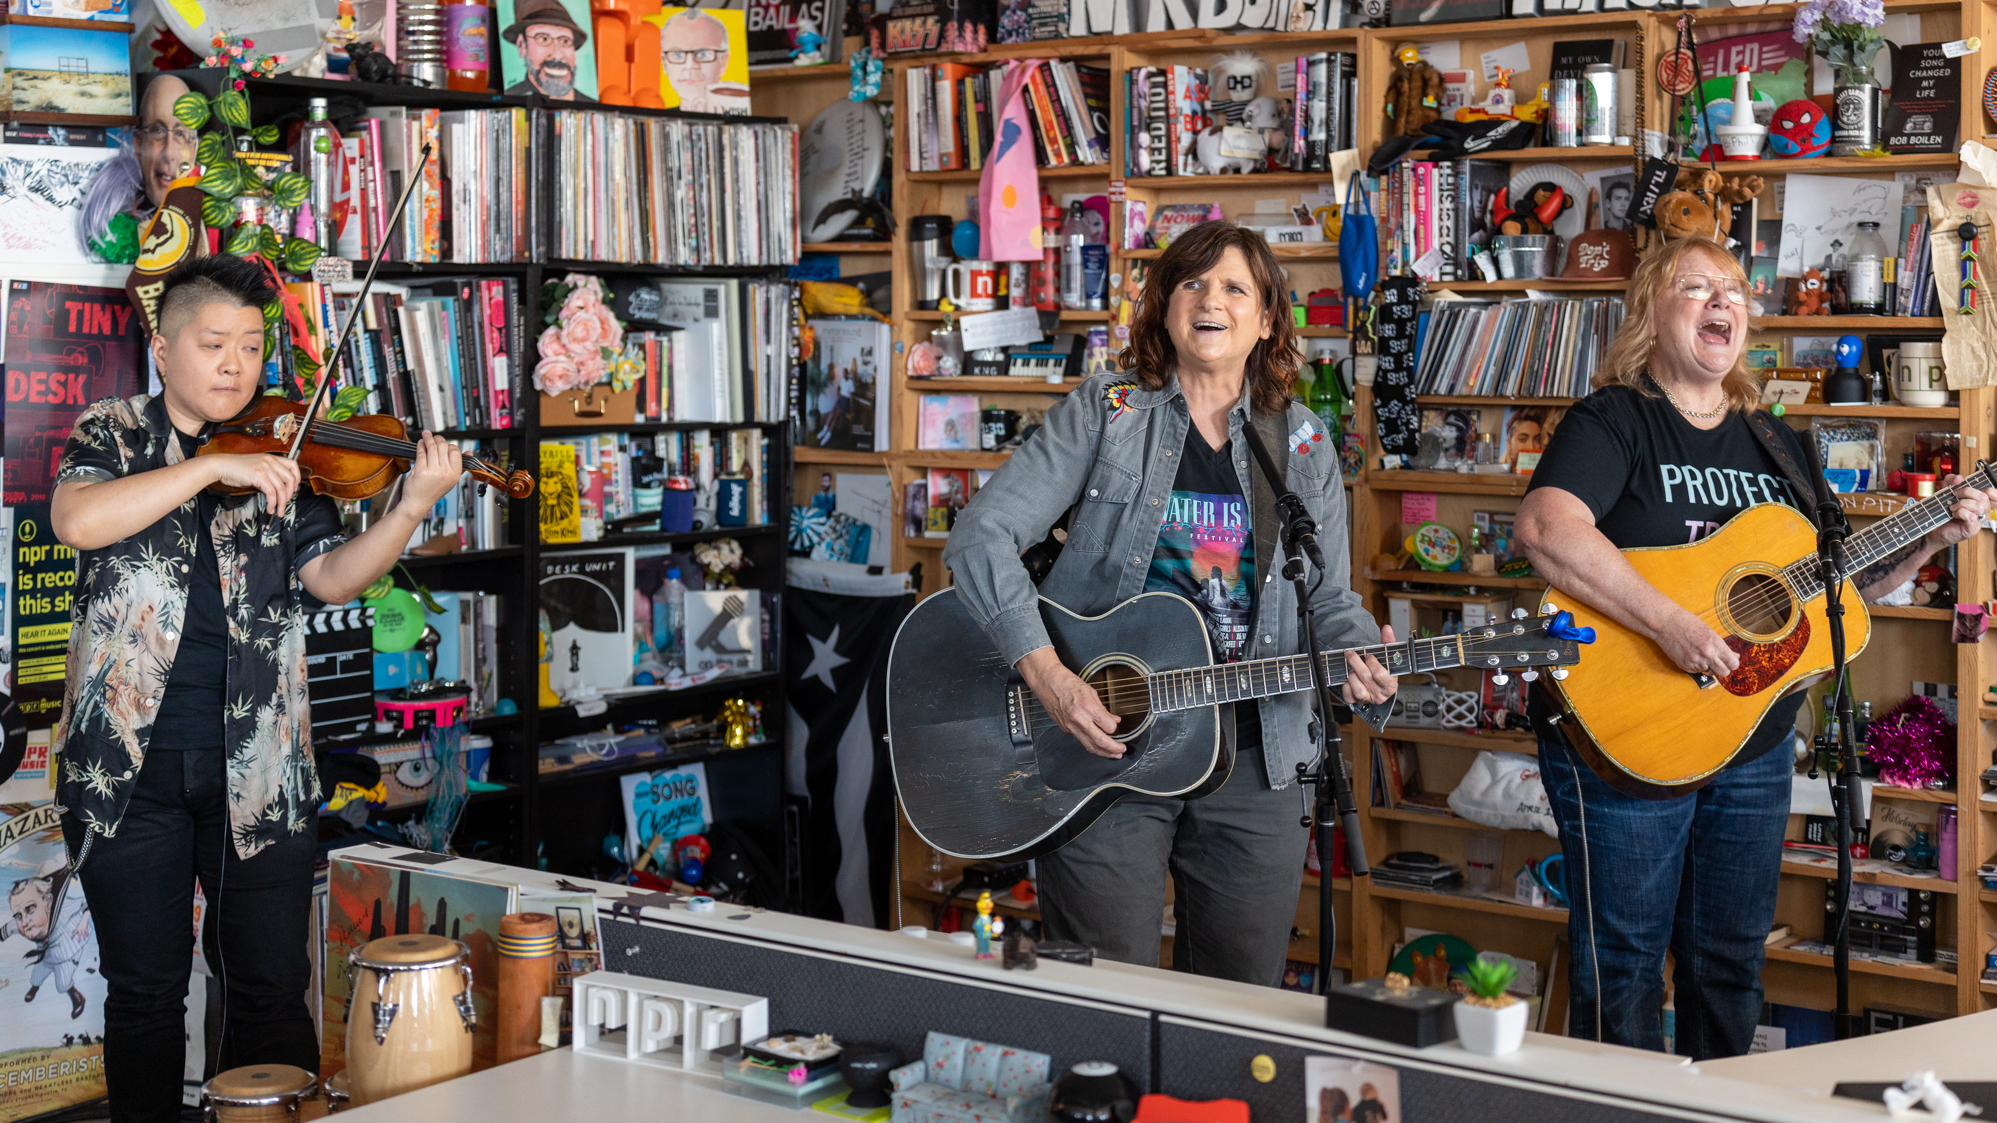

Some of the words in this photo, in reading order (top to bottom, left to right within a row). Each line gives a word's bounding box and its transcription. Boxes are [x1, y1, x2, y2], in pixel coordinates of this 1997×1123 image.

[748, 3, 822, 31] BAILAS
[886, 15, 941, 52] KISS
[1909, 68, 1951, 78] CHANGED
[1920, 59, 1944, 67] SONG
[1167, 73, 1175, 92] ASK
[1554, 70, 1583, 80] DEVI
[1921, 79, 1935, 88] MY
[1183, 83, 1212, 103] ASK
[1915, 89, 1936, 98] LIFE
[1168, 94, 1176, 116] BOB
[1150, 122, 1167, 177] REED
[1889, 136, 1908, 145] BOB
[1909, 135, 1943, 144] BOILEN
[1161, 213, 1201, 225] NOW
[1578, 241, 1611, 260] Don't
[1579, 256, 1609, 272] Trip
[977, 275, 993, 298] n
[65, 301, 133, 337] TINY
[512, 292, 520, 327] LEONARD
[512, 328, 520, 366] BERNSTEIN
[387, 346, 397, 379] FAMILY
[1902, 364, 1944, 389] np
[5, 370, 88, 406] DESK
[541, 449, 572, 460] YBILL
[1660, 464, 1799, 511] PROTECT
[1223, 500, 1241, 528] IS
[1862, 498, 1896, 513] PIT
[1190, 533, 1244, 543] FESTIVAL
[1685, 520, 1722, 545] TR
[19, 544, 50, 567] npr
[546, 562, 581, 575] DESK
[585, 560, 617, 573] UNIT
[19, 569, 34, 590] is
[37, 570, 75, 589] reco
[19, 593, 51, 615] this
[55, 591, 74, 612] sh
[21, 631, 39, 640] HEAR
[40, 630, 46, 638] IT
[47, 628, 70, 637] AGAIN.
[338, 652, 356, 661] DATE
[698, 660, 712, 672] on
[650, 779, 697, 805] SONG
[638, 798, 702, 838] Changed
[1516, 802, 1541, 813] APRIL
[1881, 807, 1918, 832] Holiday
[587, 986, 741, 1052] npr
[0, 1055, 37, 1069] RFORMED
[0, 1054, 104, 1089] CEMBERIST
[0, 1090, 17, 1098] HERS
[76, 1073, 104, 1083] BASTARD
